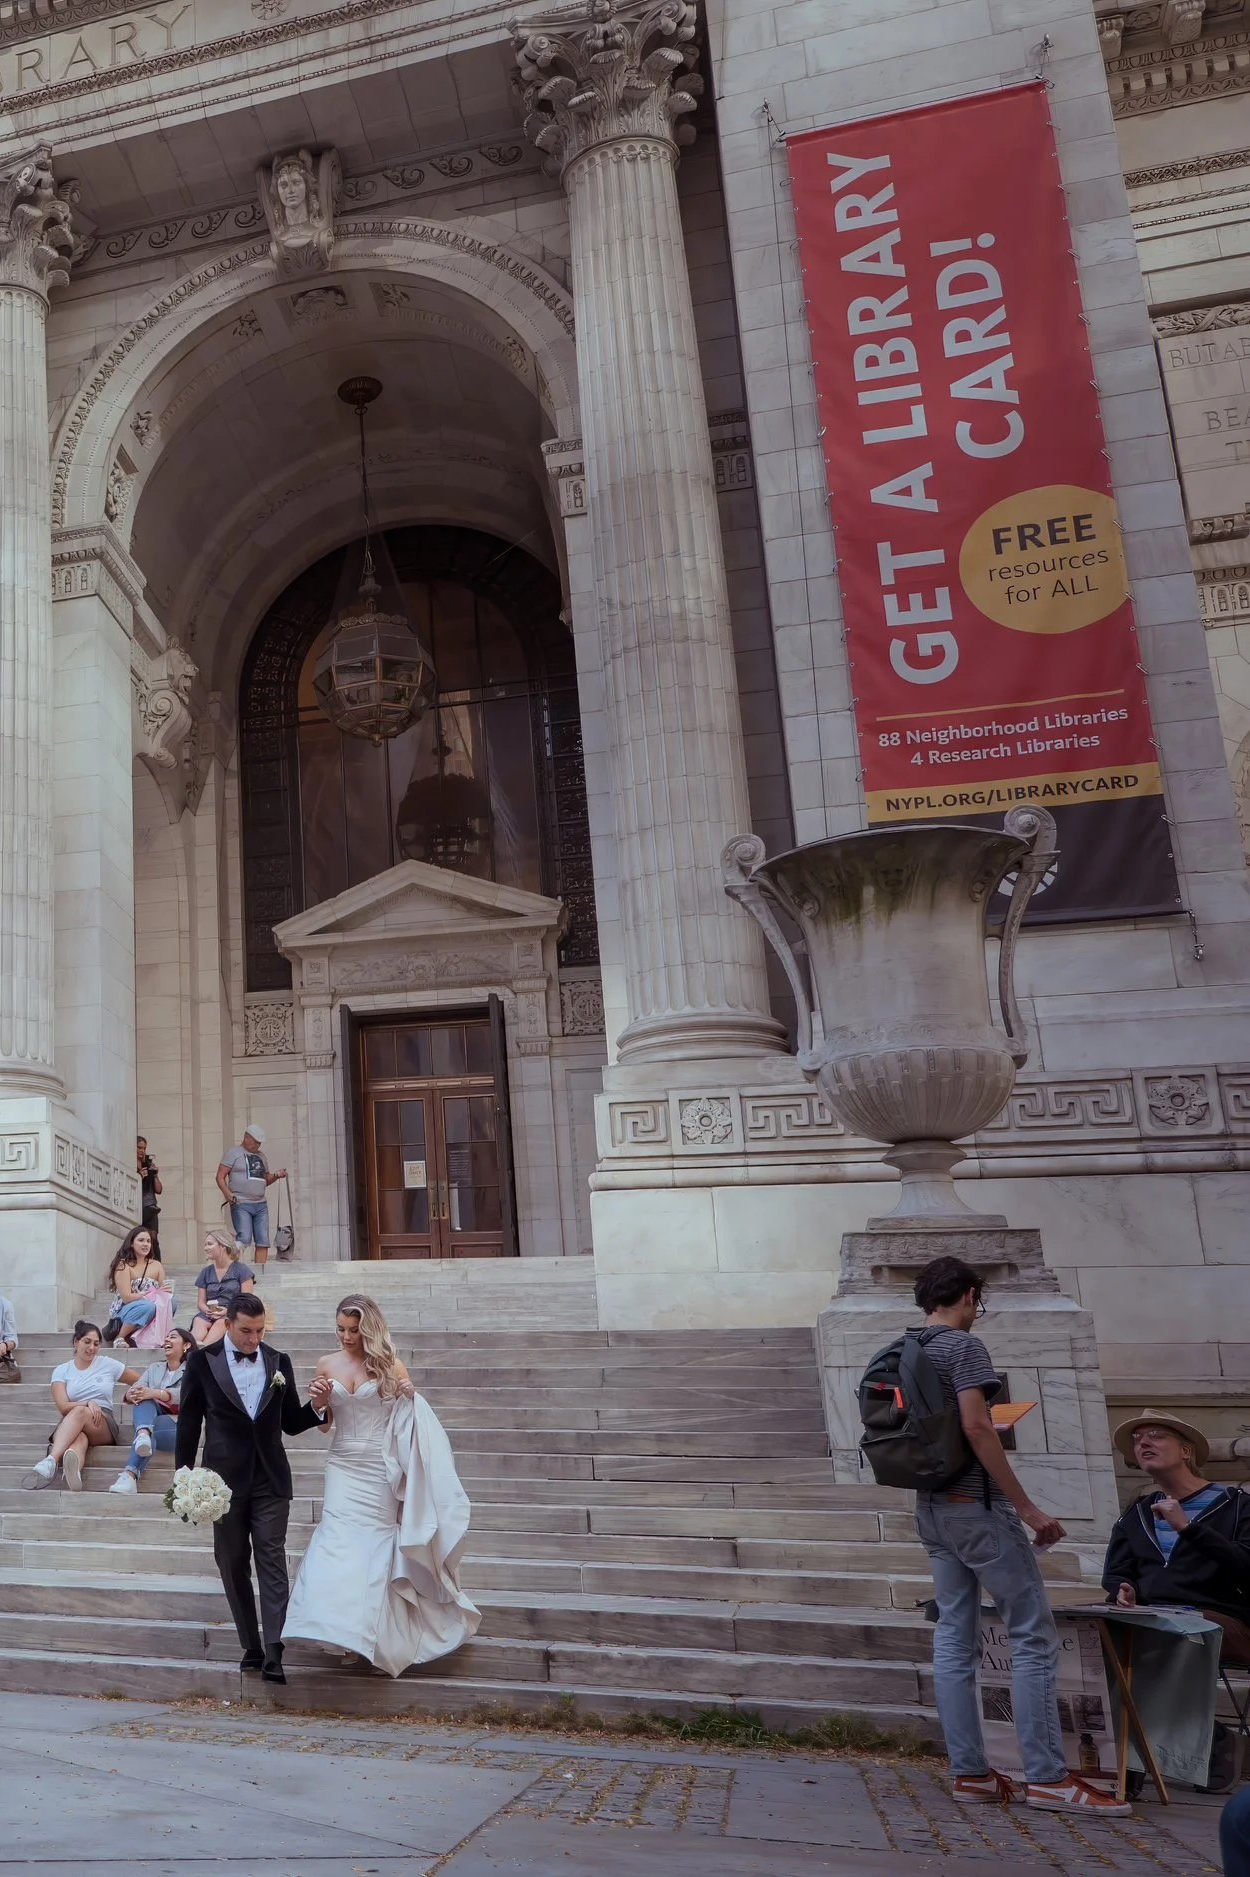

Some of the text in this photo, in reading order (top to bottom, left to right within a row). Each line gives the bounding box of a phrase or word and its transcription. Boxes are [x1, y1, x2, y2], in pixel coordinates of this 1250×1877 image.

[930, 232, 1025, 459] CARD!
[1168, 342, 1216, 369] BUT
[826, 152, 959, 685] GET A LIBRARY
[1204, 403, 1250, 431] BE
[991, 513, 1096, 556] FREE
[988, 549, 1110, 582] resources
[1004, 575, 1099, 605] for ALL
[877, 706, 1129, 748] 88 Neighborhood Libraries
[910, 733, 1101, 766] 4 Research Libraries
[885, 774, 1140, 813] NYPL.ORG/LIBRARYCARD
